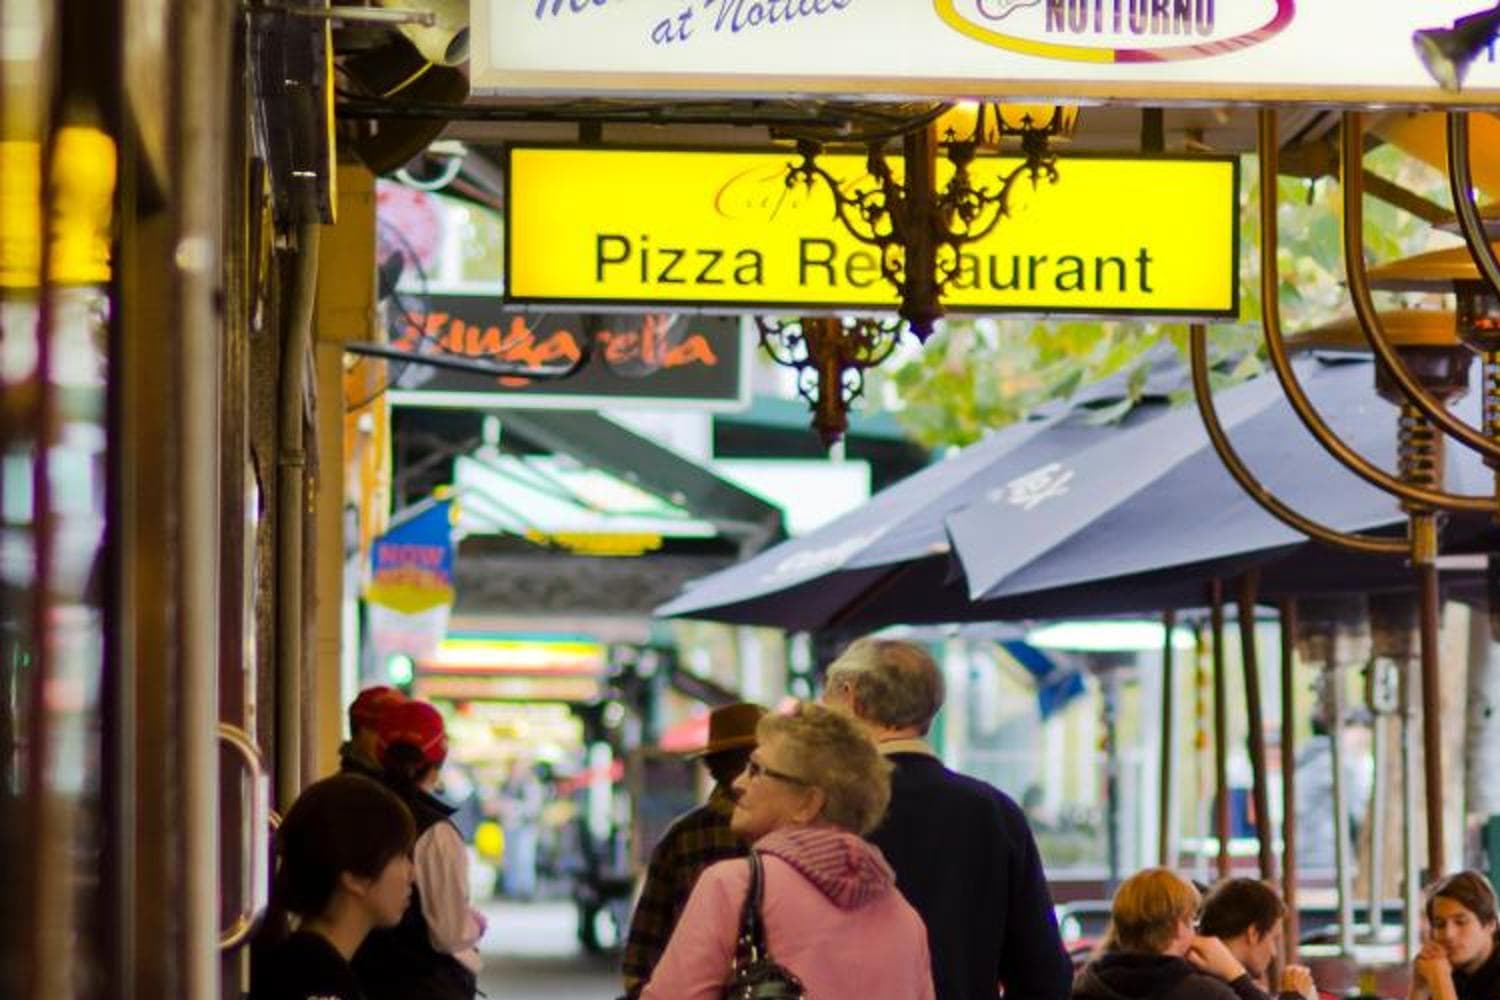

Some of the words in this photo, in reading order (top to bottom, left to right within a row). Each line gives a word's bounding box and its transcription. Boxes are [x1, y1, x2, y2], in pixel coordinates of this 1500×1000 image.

[651, 6, 693, 45] at
[595, 233, 766, 288] Pizza
[798, 236, 1155, 295] Reaurant
